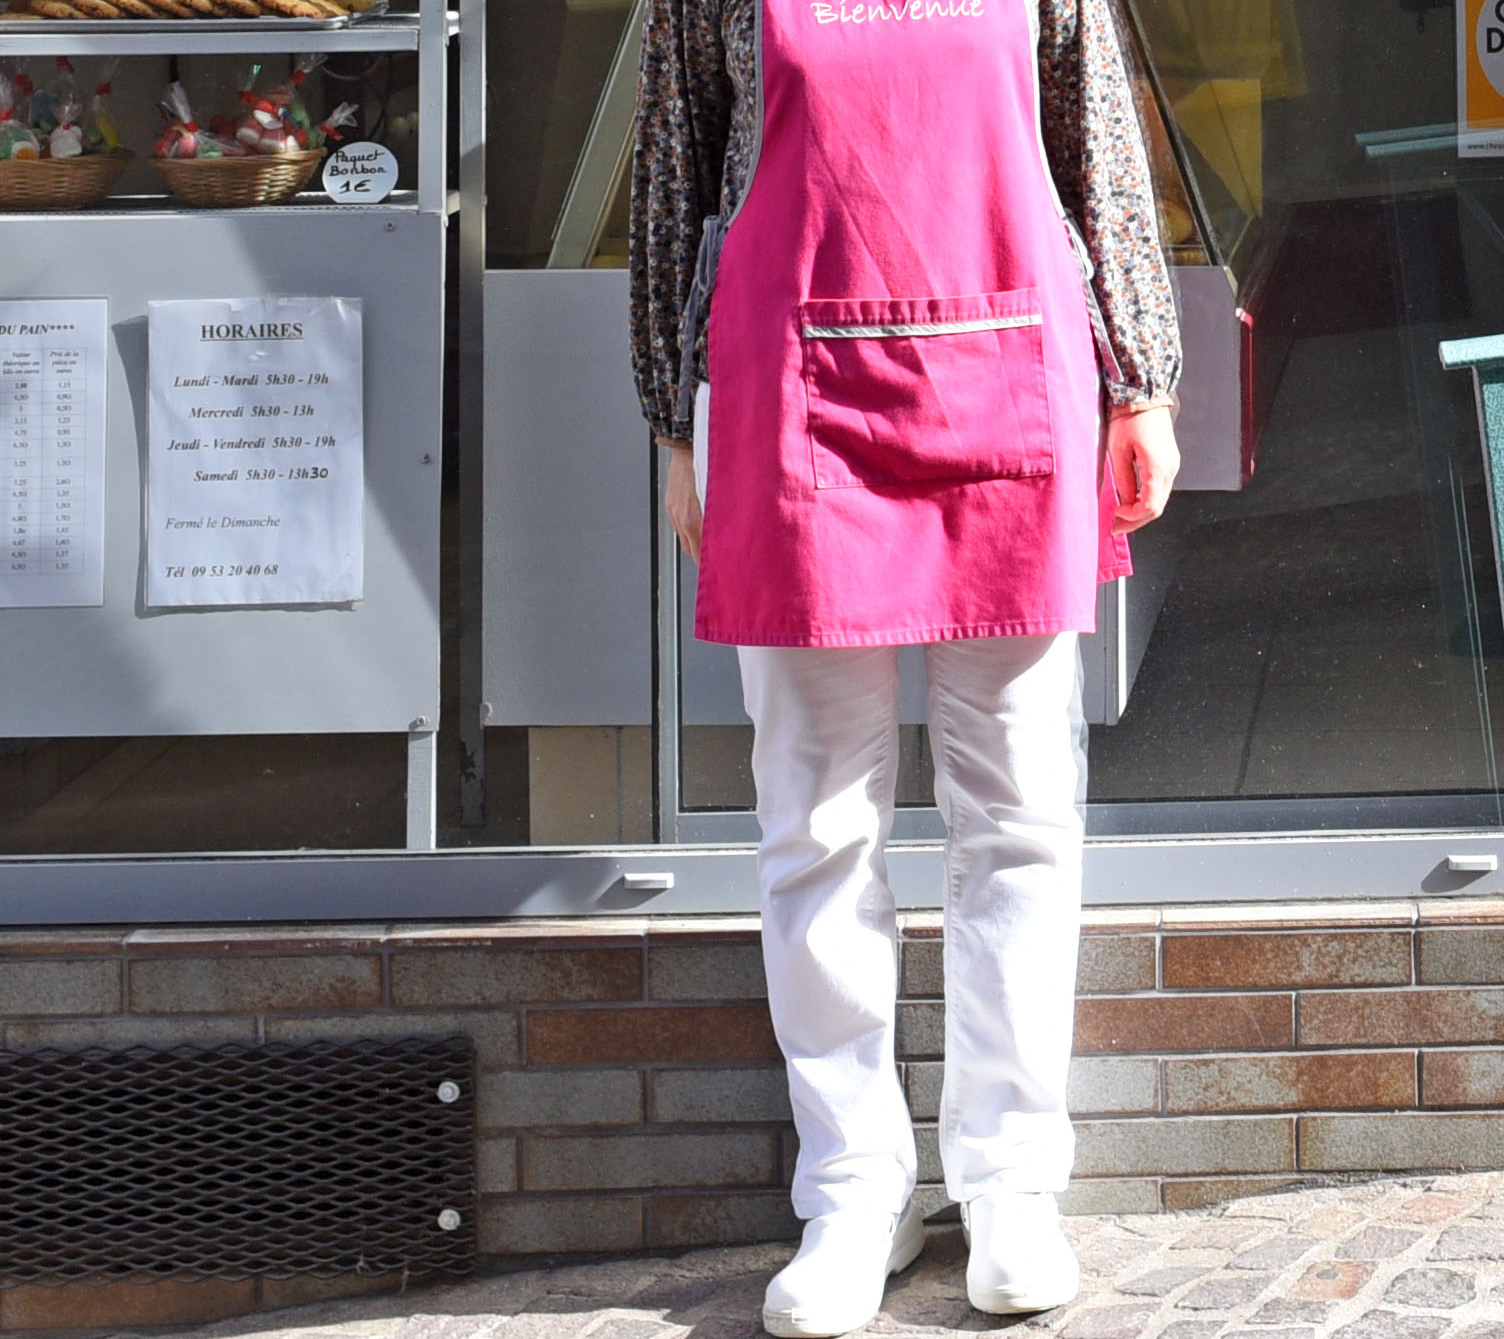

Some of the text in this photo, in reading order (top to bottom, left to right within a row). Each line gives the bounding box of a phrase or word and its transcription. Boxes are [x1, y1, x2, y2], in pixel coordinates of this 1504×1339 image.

[335, 148, 385, 167] Paquet
[329, 163, 387, 176] Bonbon
[201, 323, 304, 339] HORAIRES
[174, 375, 210, 387] Lundi
[222, 374, 259, 386] Mardi
[265, 374, 295, 385] 5h30
[307, 373, 329, 385] 19h
[188, 406, 244, 419] Mercredi
[251, 406, 280, 417] 5h30
[293, 405, 314, 417] 13h
[167, 439, 200, 451] Jeudi
[213, 437, 265, 449] Vendredi
[272, 437, 302, 448] 5h30
[315, 436, 336, 448] 19h
[194, 470, 239, 482] Samedi
[246, 470, 275, 480] 5h30
[288, 467, 328, 480] 13h30
[165, 515, 280, 529] Fermé le Dimanche
[165, 564, 279, 578] Tél 09 53 20 40 68
